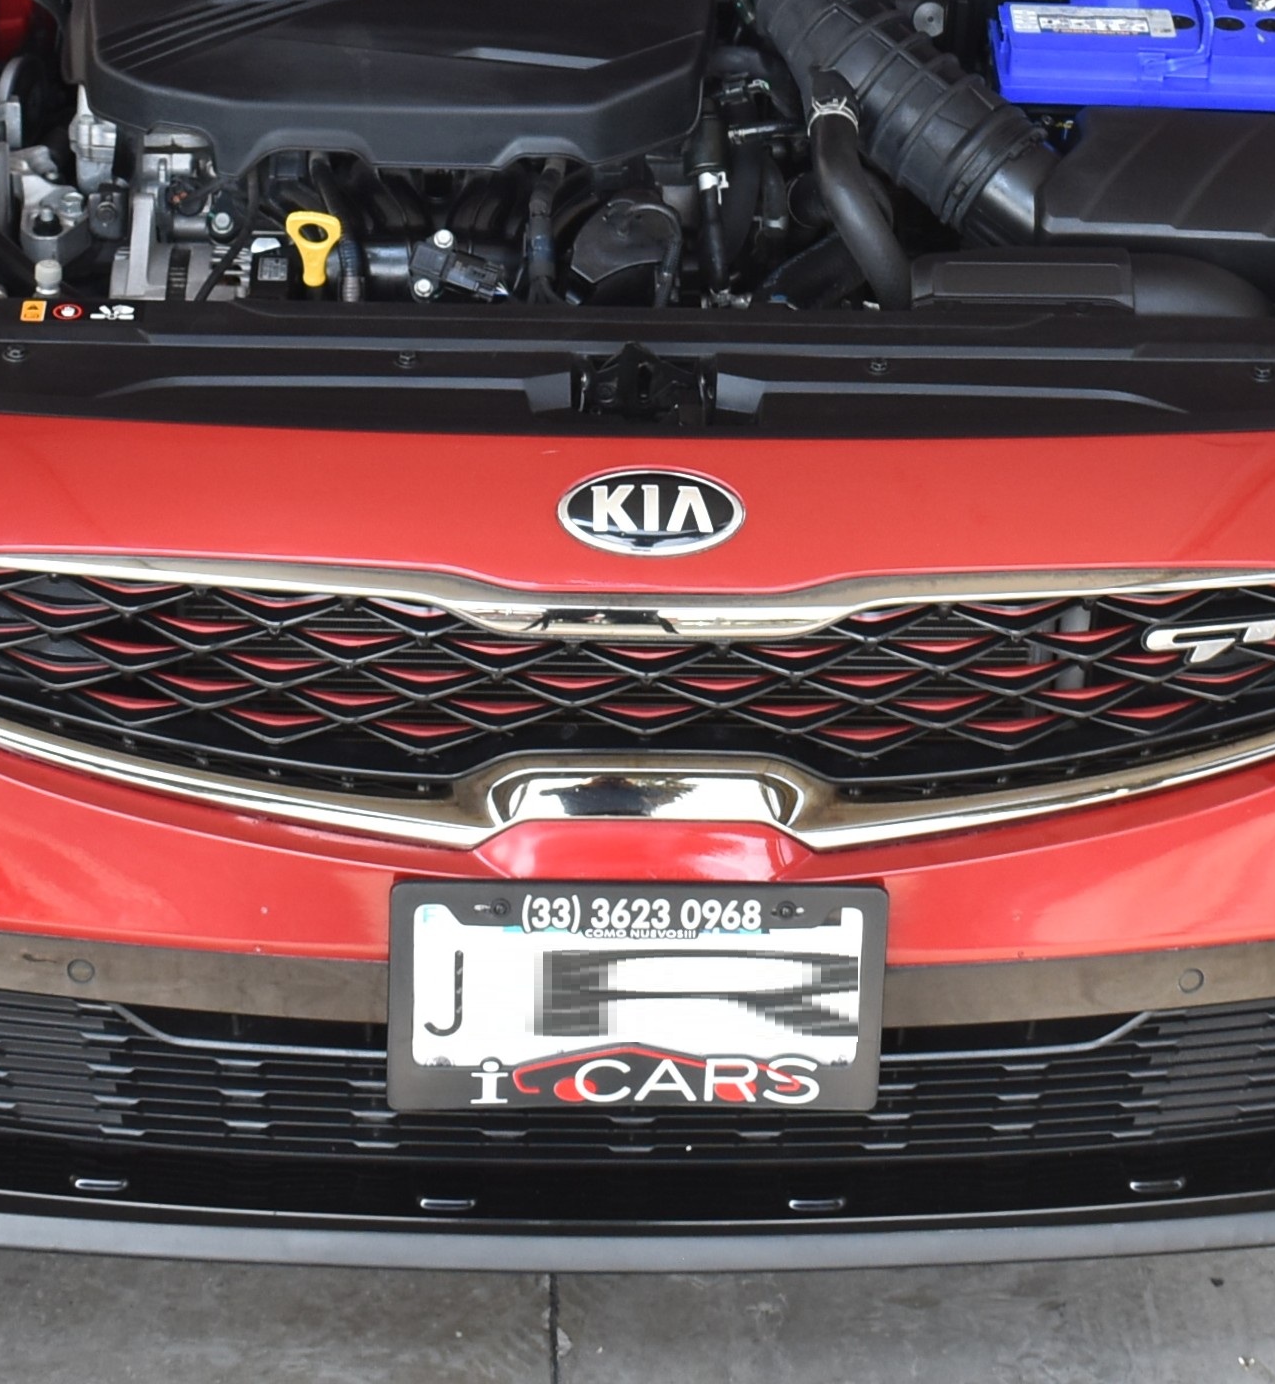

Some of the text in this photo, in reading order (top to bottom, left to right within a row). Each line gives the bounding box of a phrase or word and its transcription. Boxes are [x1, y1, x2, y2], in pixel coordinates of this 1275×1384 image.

[591, 485, 714, 533] KIA
[522, 894, 762, 934] (33) 3623 0968
[584, 928, 627, 939] COMO
[471, 1057, 820, 1104] i CARS
